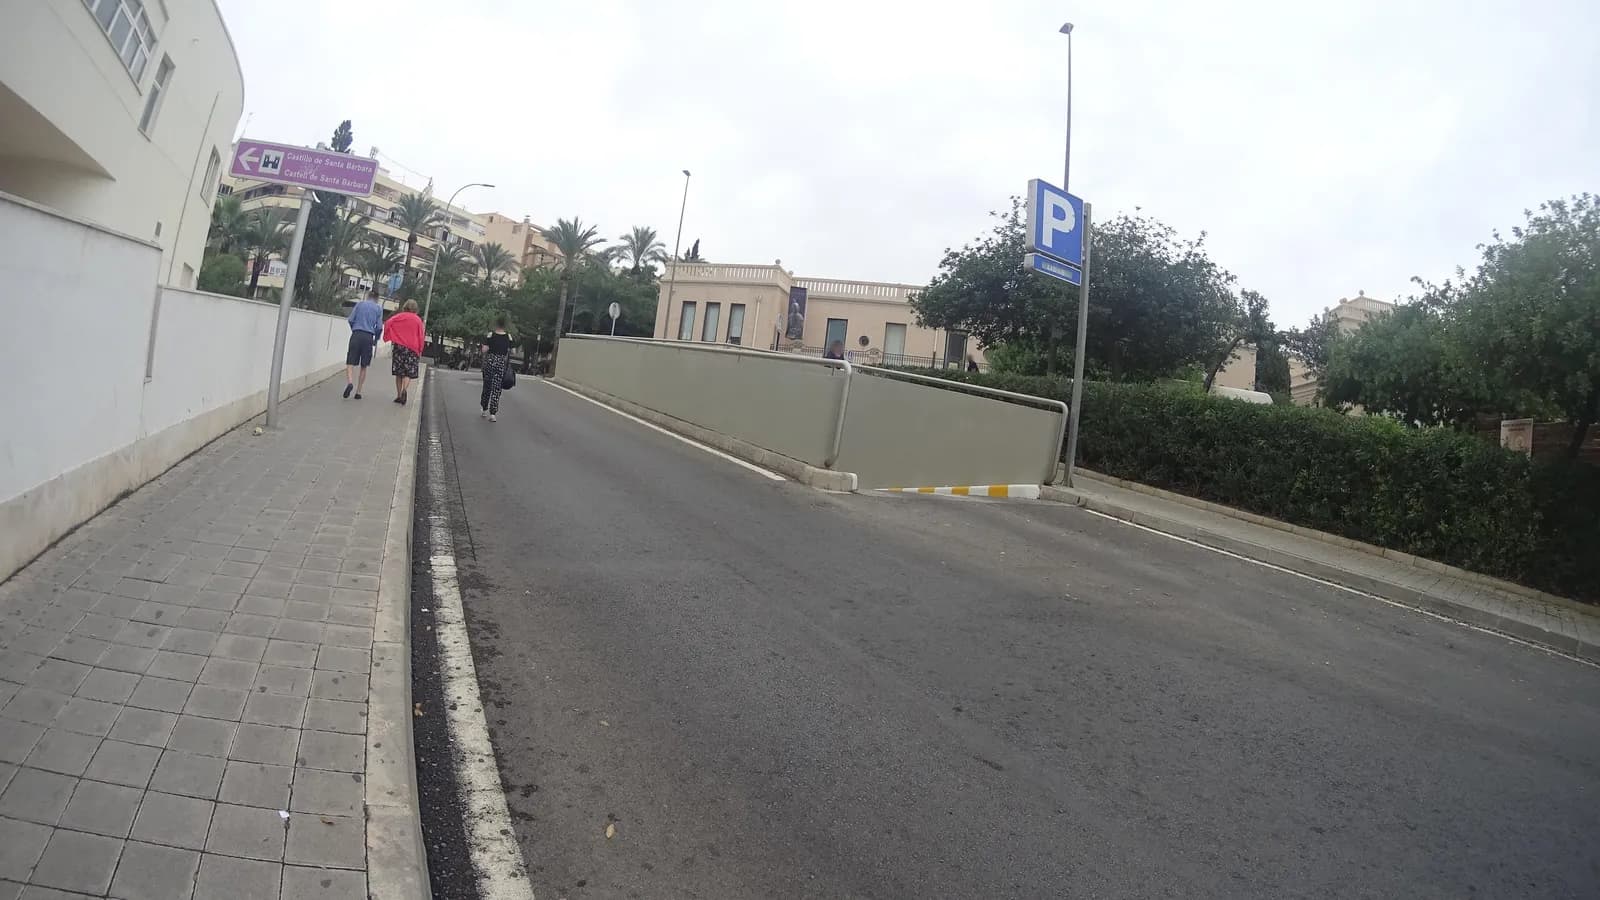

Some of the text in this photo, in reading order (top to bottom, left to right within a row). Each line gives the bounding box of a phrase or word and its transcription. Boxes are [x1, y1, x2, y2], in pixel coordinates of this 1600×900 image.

[287, 152, 312, 163] Castillo
[314, 157, 323, 165] de
[324, 158, 344, 169] Santa
[284, 169, 307, 180] Castell
[309, 172, 318, 181] de
[320, 174, 340, 185] Santa
[1042, 189, 1075, 248] P
